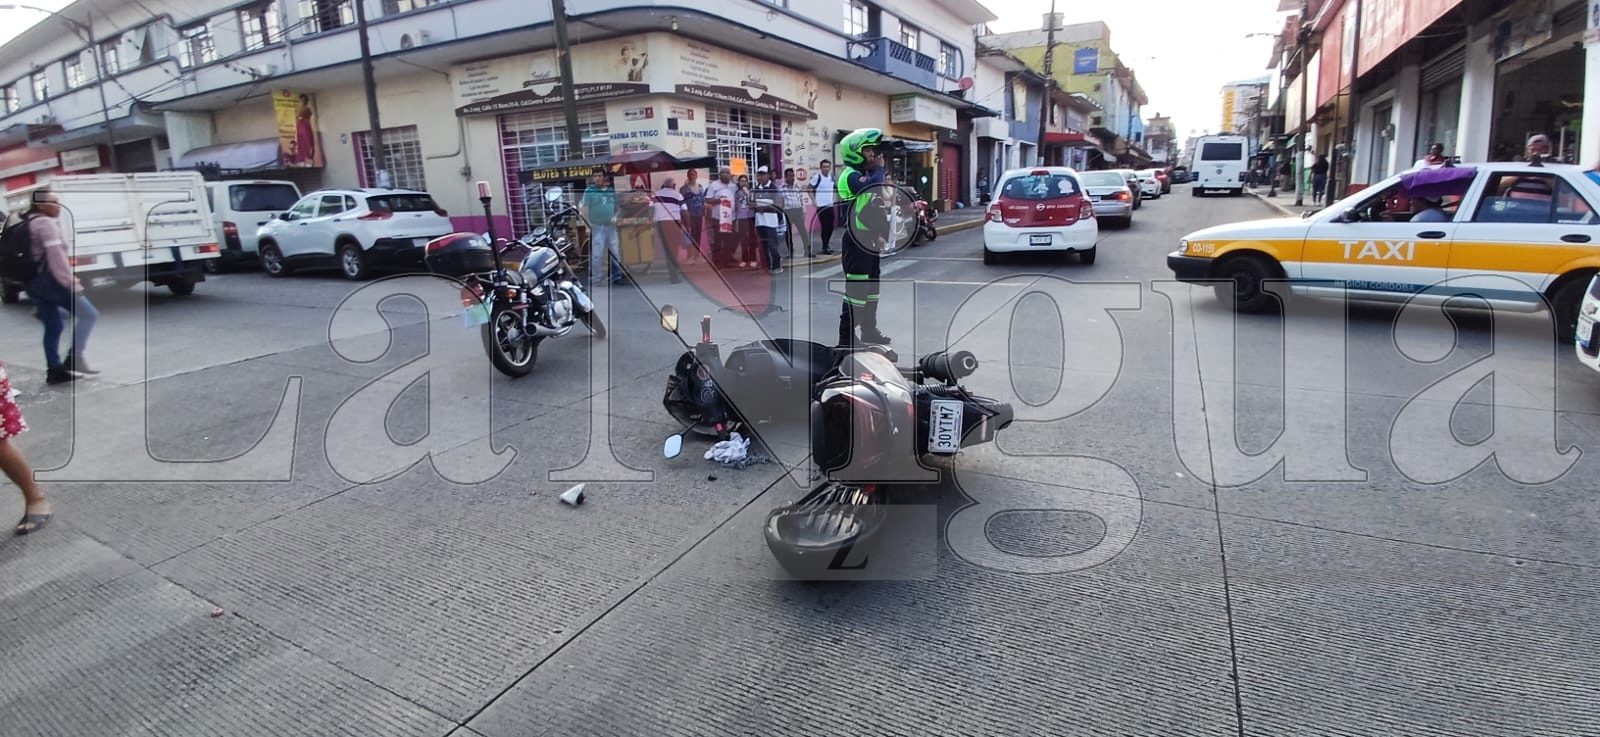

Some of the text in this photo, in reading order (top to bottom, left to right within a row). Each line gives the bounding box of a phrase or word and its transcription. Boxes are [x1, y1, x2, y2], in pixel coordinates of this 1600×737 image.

[610, 132, 629, 140] HARINA
[639, 129, 659, 137] TRIGO
[533, 168, 560, 180] ELOTES
[563, 170, 567, 178] Y
[1339, 239, 1416, 261] TAXI
[937, 406, 954, 448] 30YTM7
